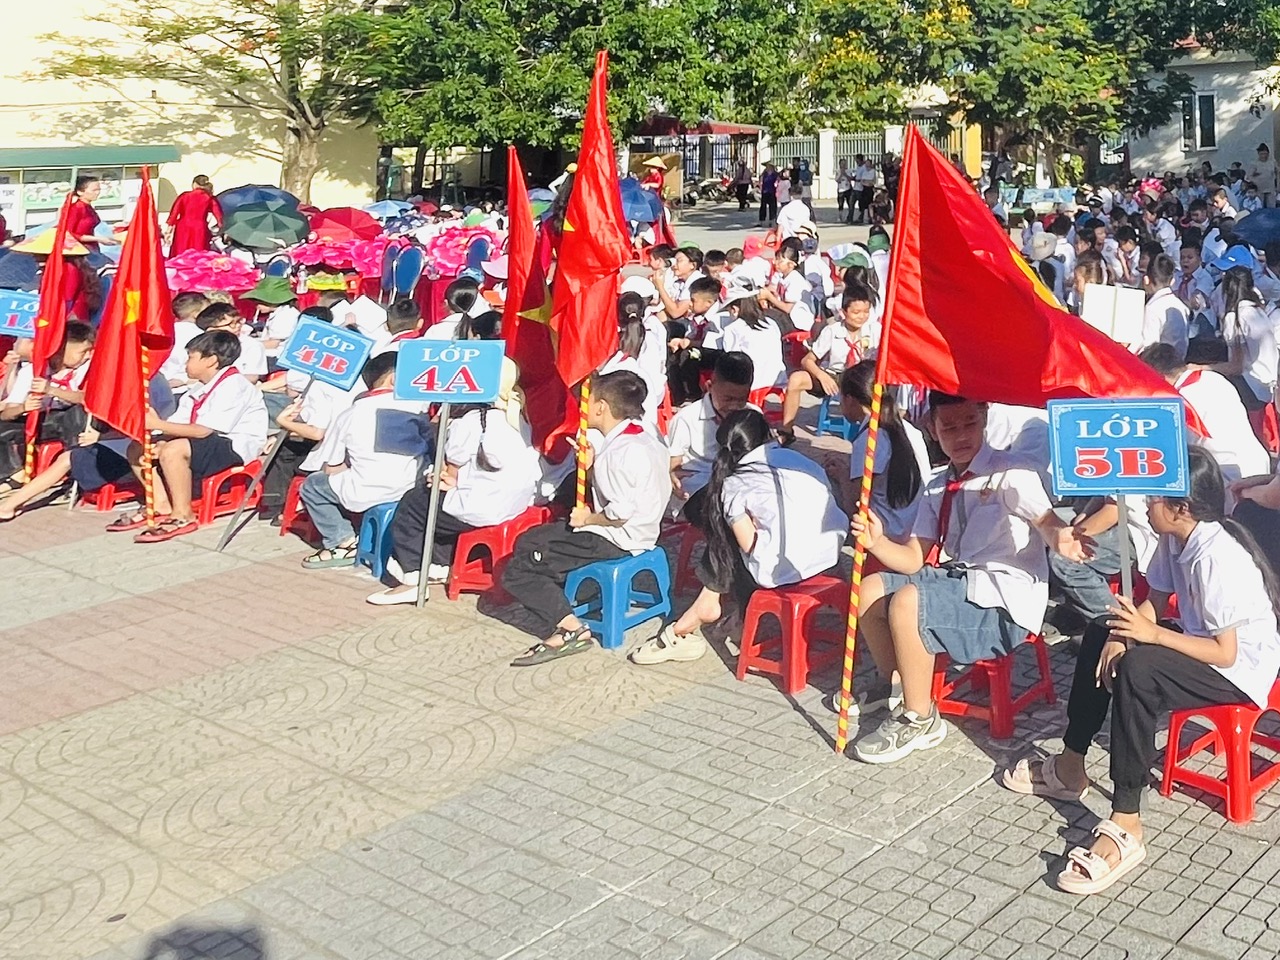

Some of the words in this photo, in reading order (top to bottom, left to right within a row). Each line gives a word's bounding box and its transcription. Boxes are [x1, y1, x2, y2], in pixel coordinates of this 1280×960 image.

[306, 330, 355, 352] LỚP
[421, 344, 480, 362] LỚP
[292, 345, 349, 375] 4B
[410, 365, 484, 394] 4A
[1075, 413, 1158, 438] LỚP
[1074, 447, 1166, 478] 5B
